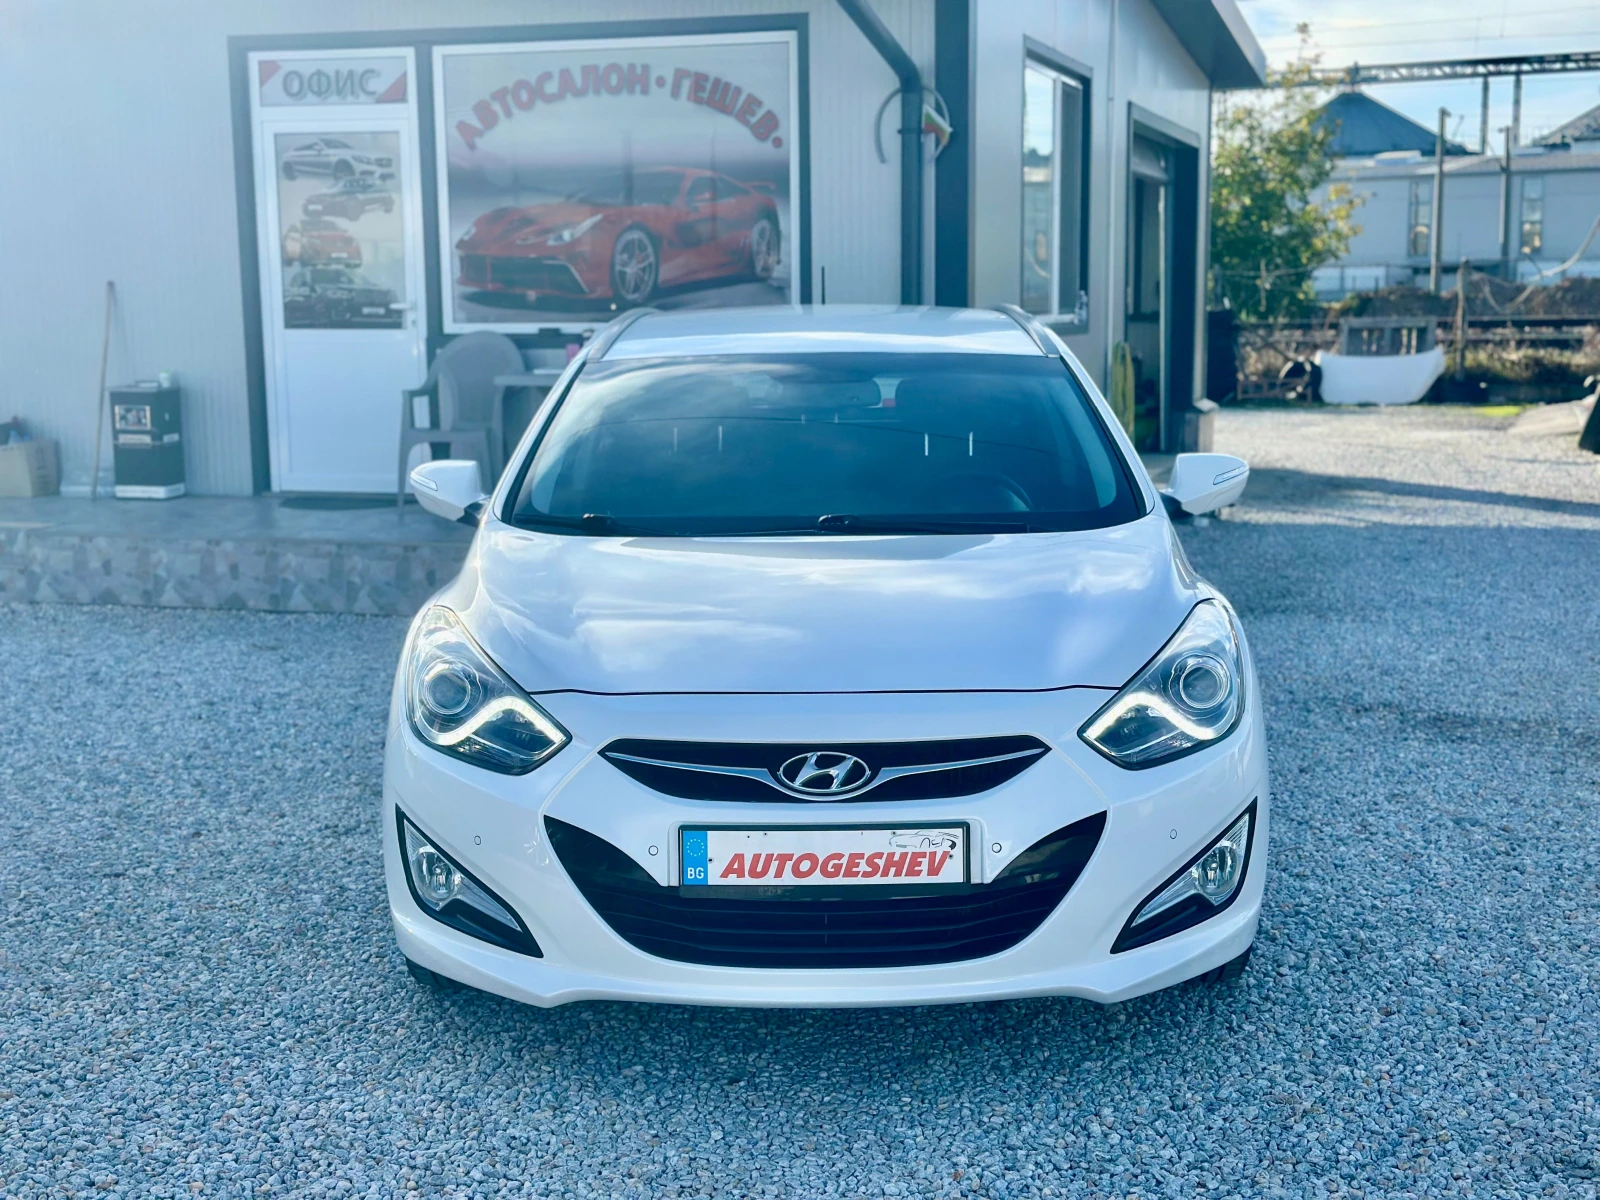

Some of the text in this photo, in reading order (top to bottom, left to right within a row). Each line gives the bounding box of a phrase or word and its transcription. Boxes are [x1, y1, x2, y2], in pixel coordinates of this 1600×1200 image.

[282, 68, 379, 100] ОФИС
[455, 62, 780, 151] АВТОСАЛОН ГЕШЕВ
[687, 867, 705, 880] BG
[719, 850, 951, 880] AUTOGESHEV
